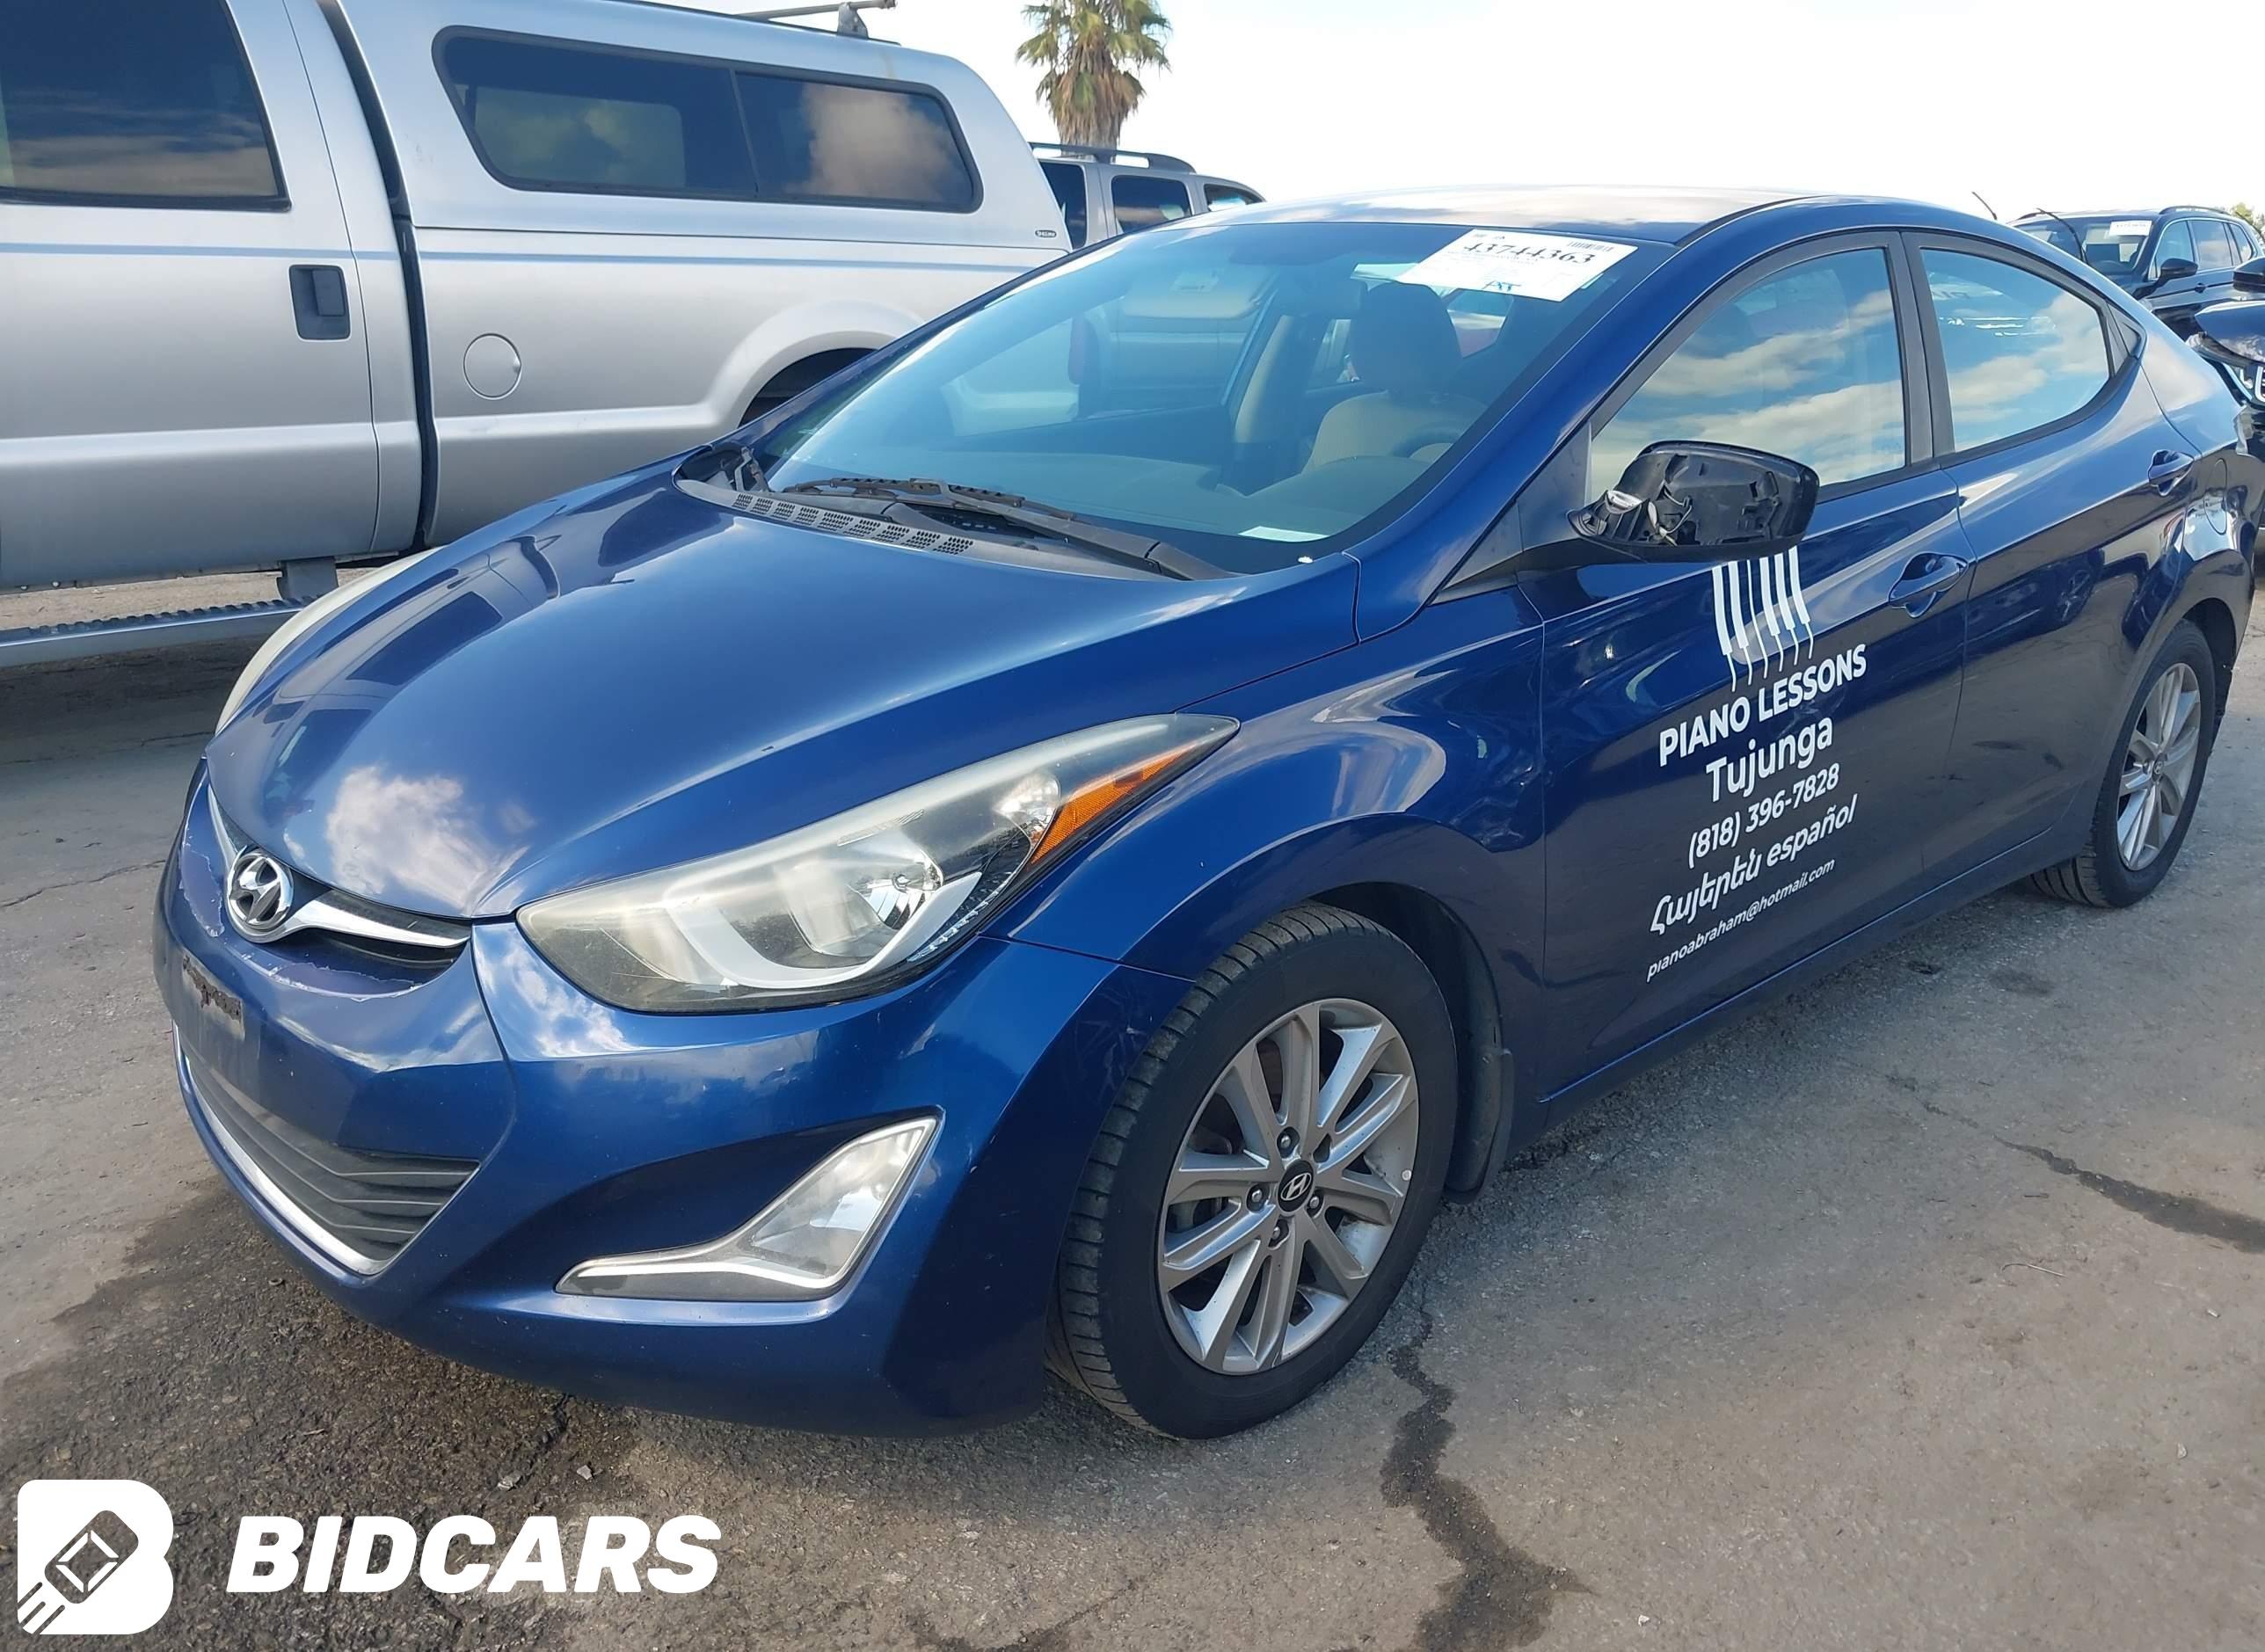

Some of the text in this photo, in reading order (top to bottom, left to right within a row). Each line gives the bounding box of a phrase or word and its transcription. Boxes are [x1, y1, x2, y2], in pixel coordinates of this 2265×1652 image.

[1463, 240, 1596, 264] 43744363
[1658, 643, 1868, 768] PIANO LESSONS
[1705, 717, 1833, 803] Tujunga
[1650, 793, 1859, 935] Հայերեն español
[1687, 762, 1840, 870] (818) 396-7828
[1646, 858, 1835, 982] pianoabraham@hotmail.com
